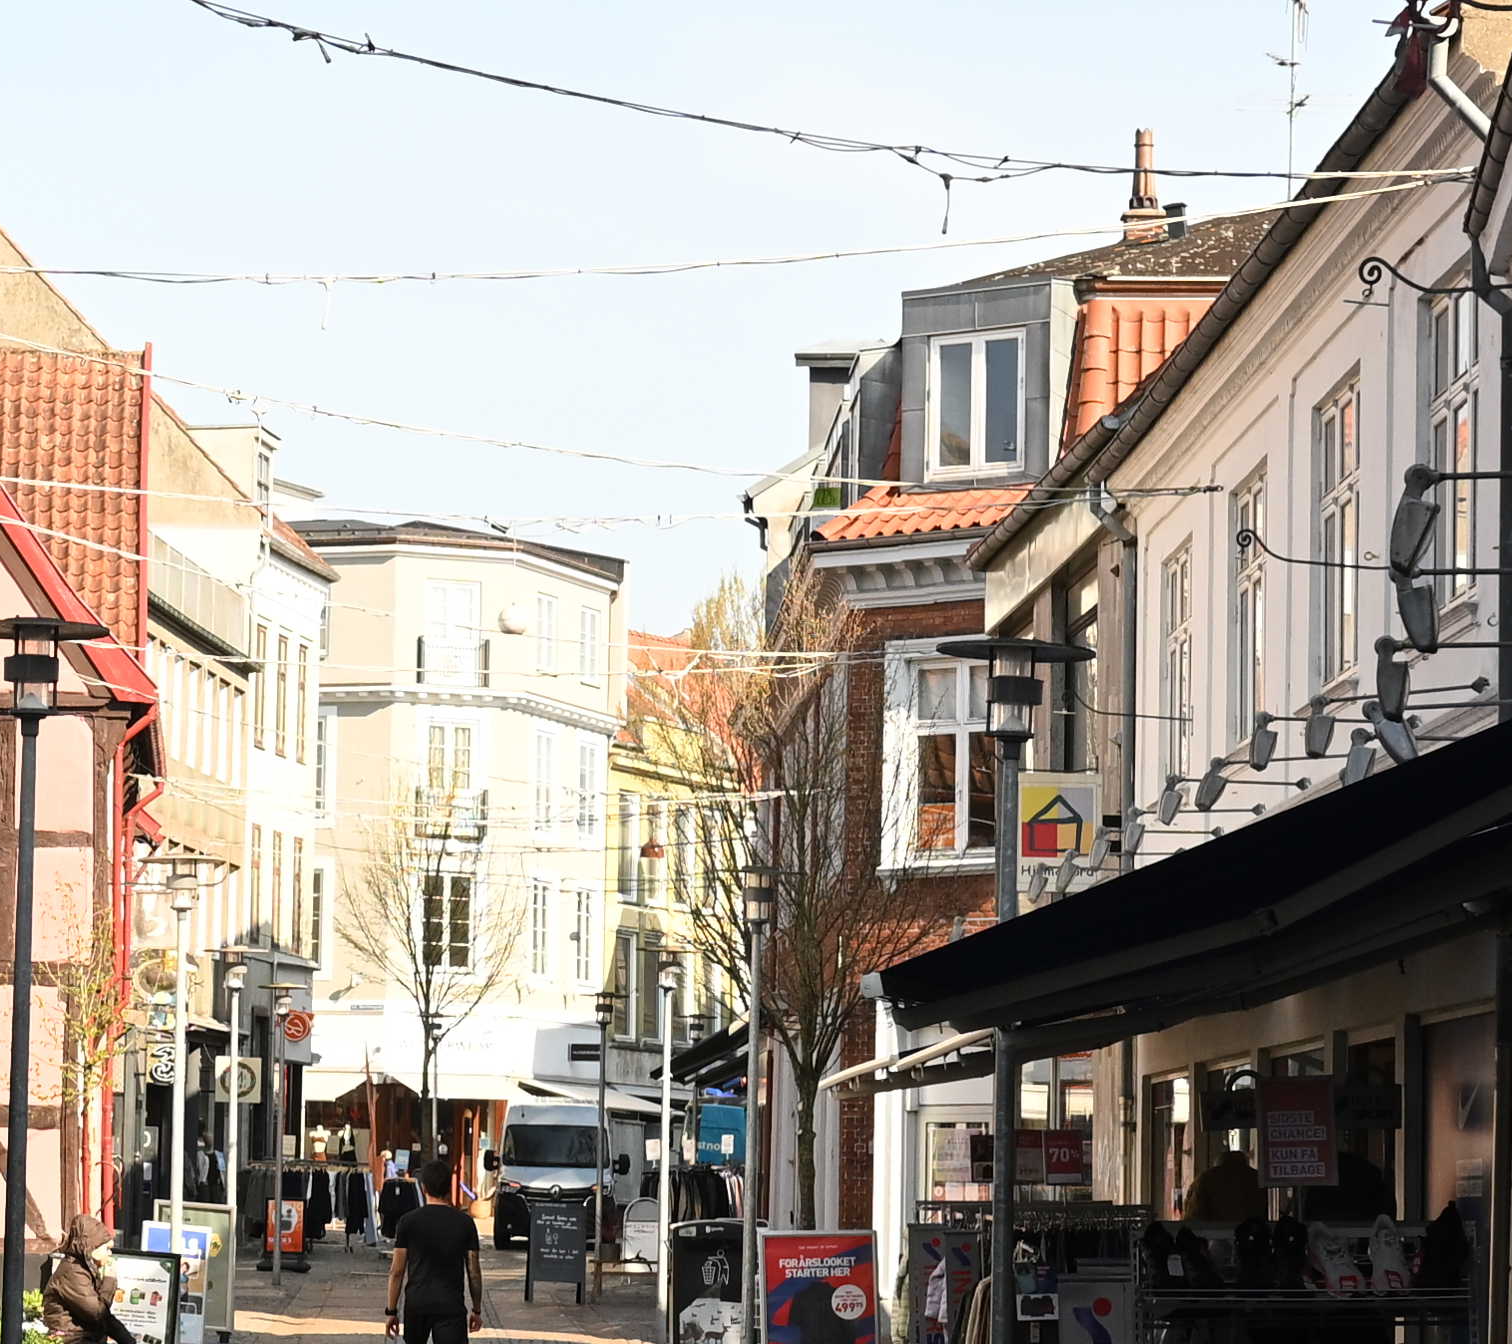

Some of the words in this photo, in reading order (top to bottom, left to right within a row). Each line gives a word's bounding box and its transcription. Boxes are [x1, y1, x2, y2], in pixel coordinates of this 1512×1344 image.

[779, 1254, 856, 1268] FORÅRSLOOKET
[785, 1267, 829, 1278] STARTER
[830, 1267, 850, 1277] HER
